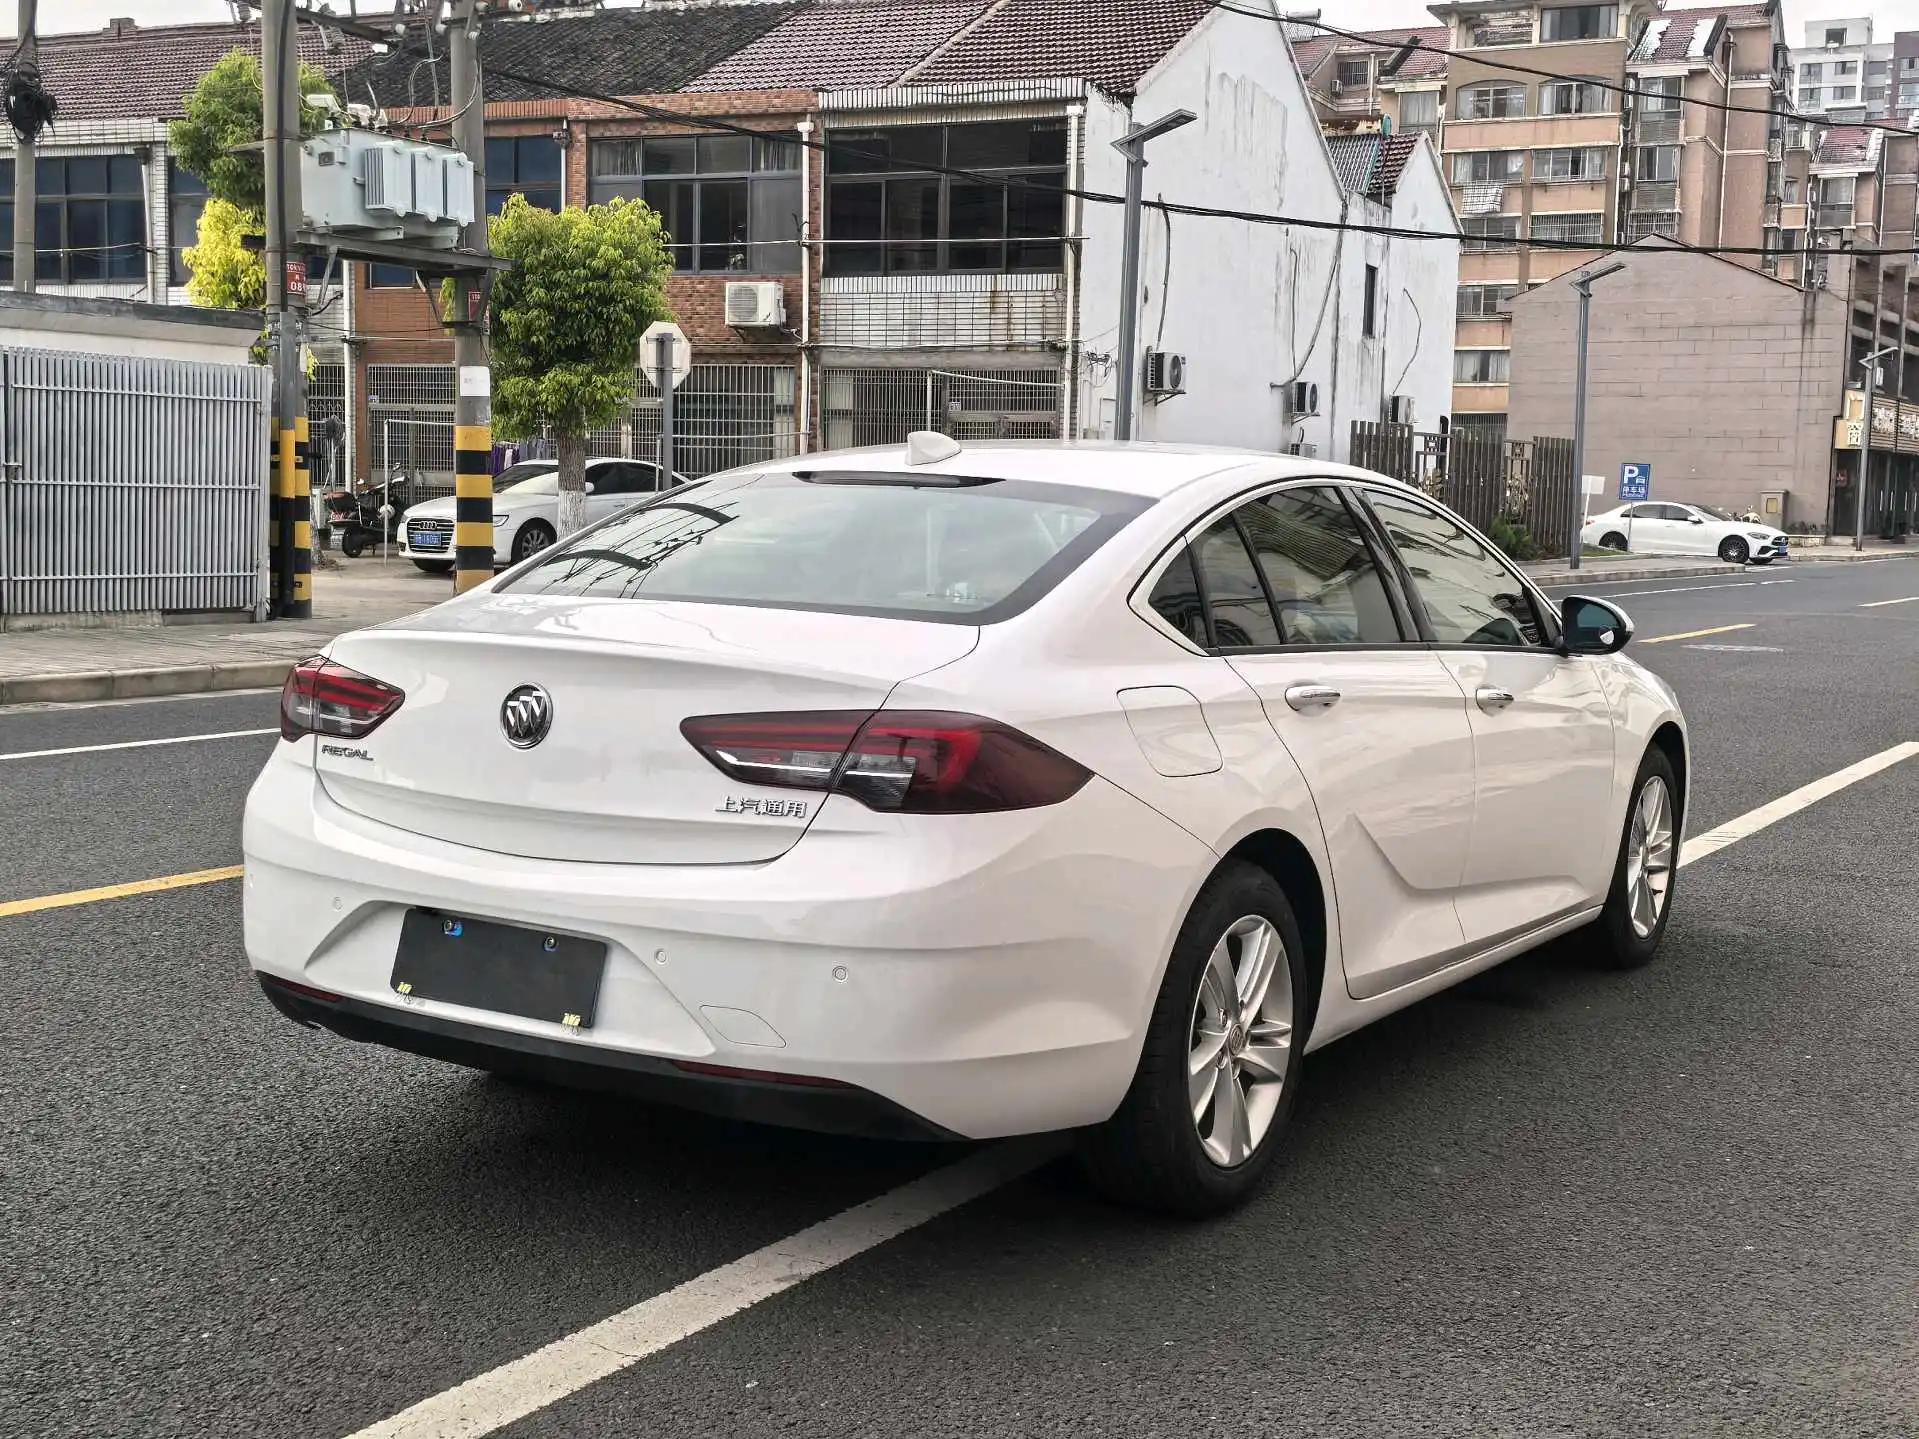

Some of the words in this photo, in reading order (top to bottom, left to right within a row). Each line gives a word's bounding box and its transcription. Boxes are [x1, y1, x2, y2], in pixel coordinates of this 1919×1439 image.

[1624, 466, 1639, 483] P
[321, 744, 374, 761] REGAL
[715, 796, 807, 818] 上汽通用
